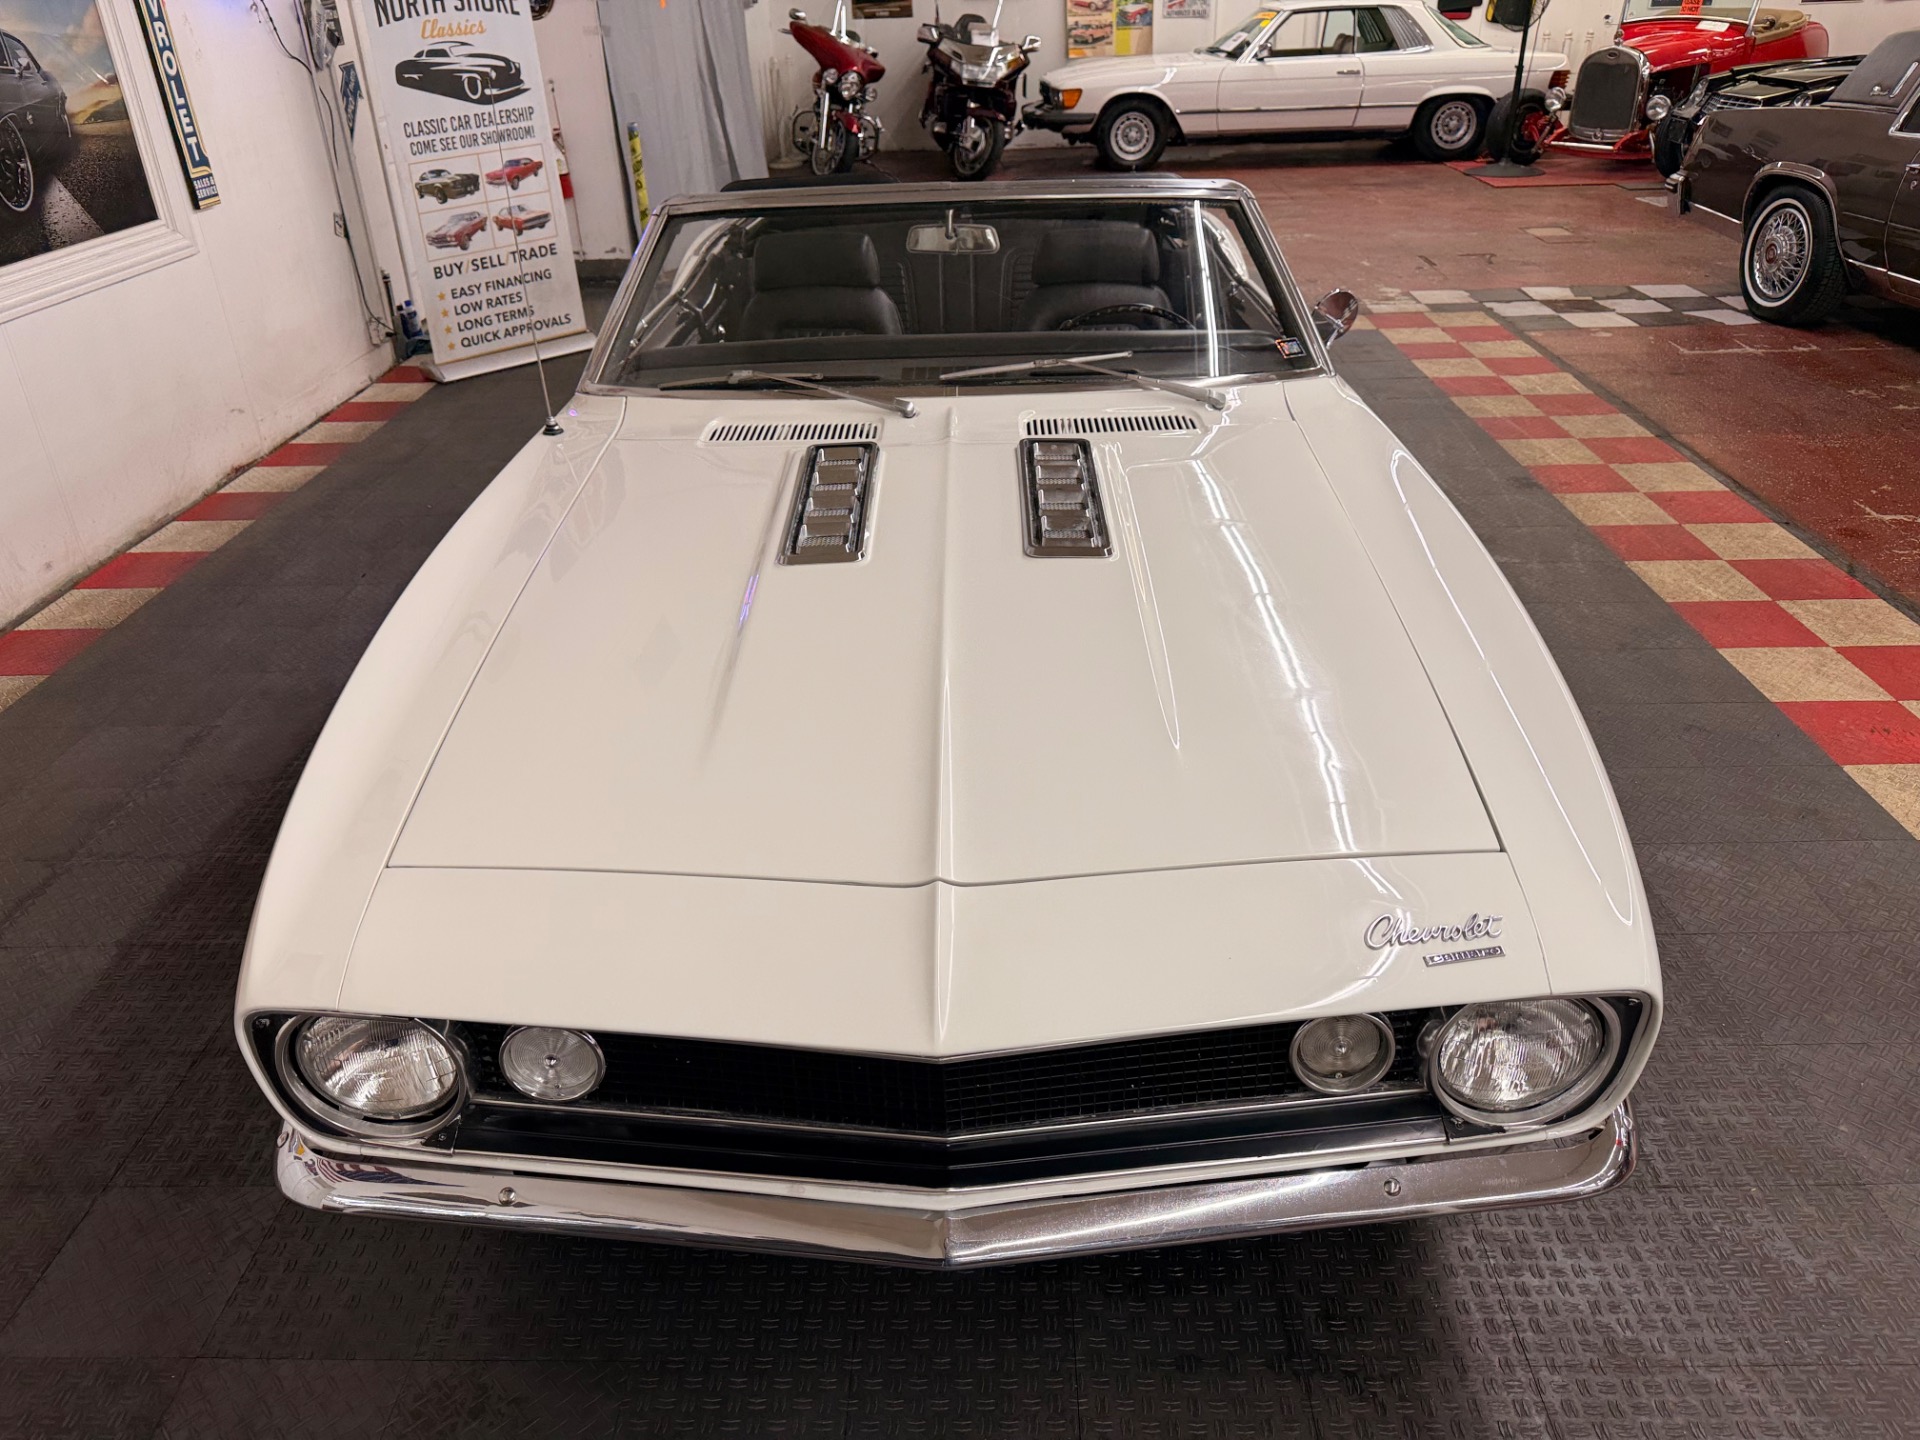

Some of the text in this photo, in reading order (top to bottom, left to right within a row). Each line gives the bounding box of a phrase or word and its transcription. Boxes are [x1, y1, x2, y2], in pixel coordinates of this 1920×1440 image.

[419, 18, 487, 40] Classics
[403, 105, 535, 139] CLASSIC CAR DEALERSHIP
[409, 125, 536, 156] COME SEE OUR SHOWROOM!
[193, 177, 209, 190] SALES
[196, 185, 218, 199] SERVICE
[451, 268, 552, 299] EASY FINANCING
[454, 292, 523, 316] LOW RATES
[457, 305, 535, 333] LONG TERMS
[460, 313, 572, 348] QUICK APPROVALS
[1364, 911, 1504, 950] Chevrolet
